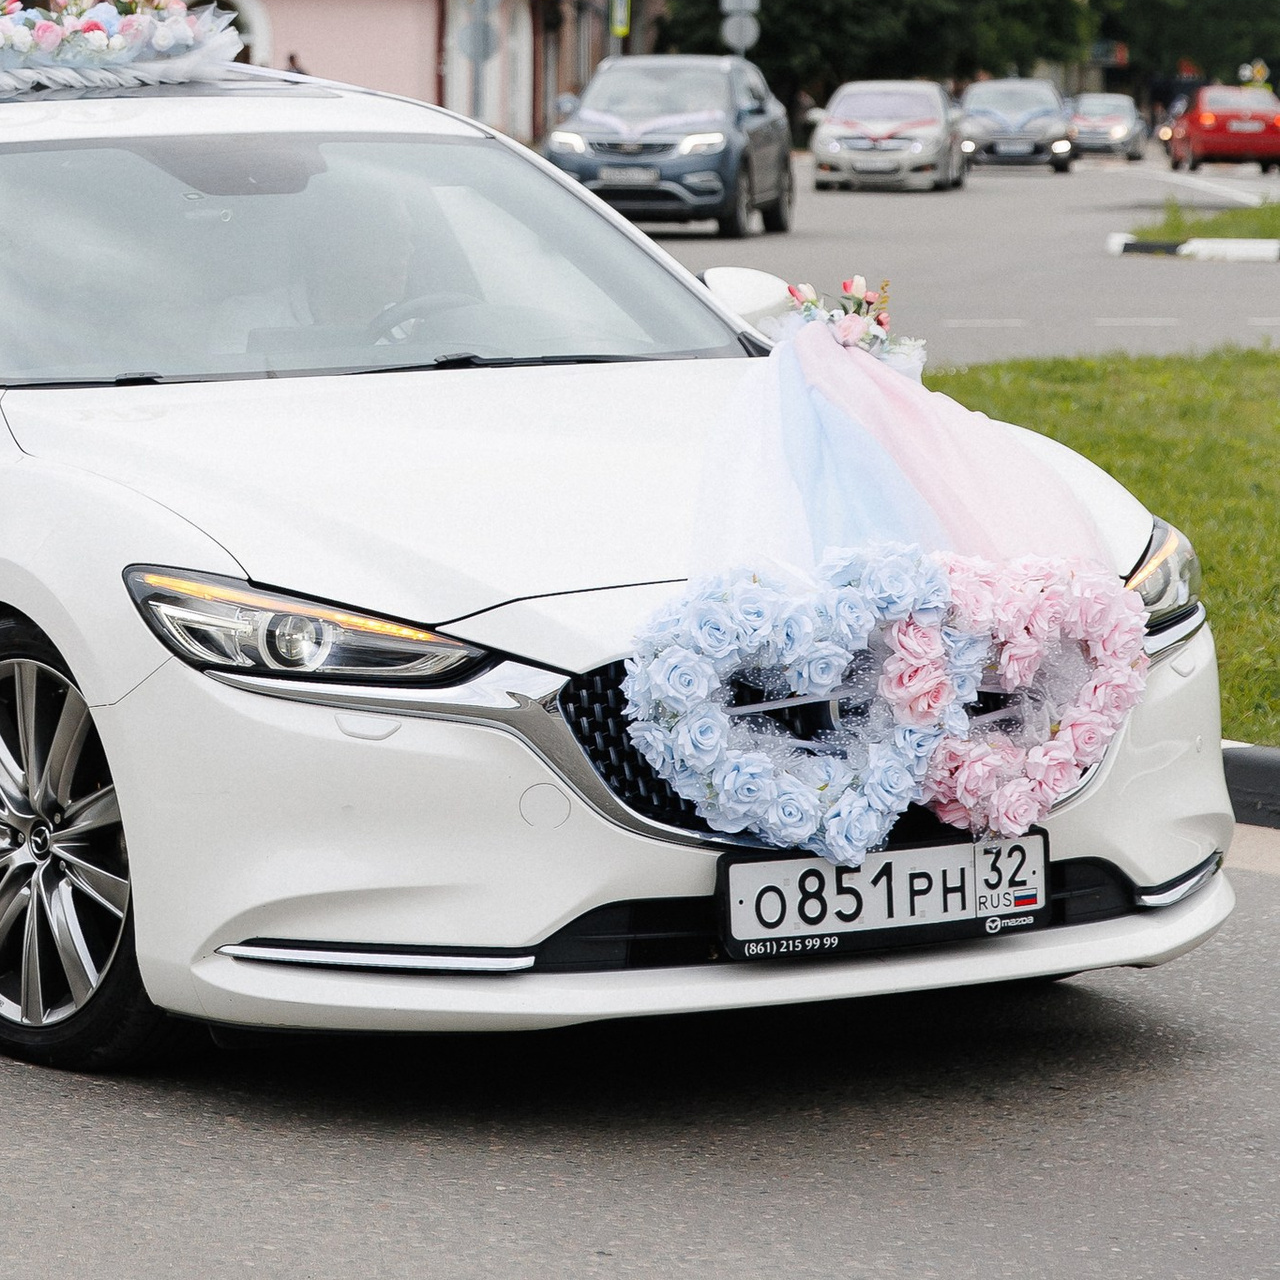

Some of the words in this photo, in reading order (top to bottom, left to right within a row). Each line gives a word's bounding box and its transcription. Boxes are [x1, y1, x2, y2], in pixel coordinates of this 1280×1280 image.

[754, 860, 967, 929] О851РН
[983, 844, 1028, 890] 32
[978, 892, 1013, 911] RUS
[1001, 915, 1035, 928] mazda
[744, 941, 777, 957] (861)
[779, 939, 803, 953] 215
[805, 937, 821, 950] 99
[823, 935, 839, 949] 99
